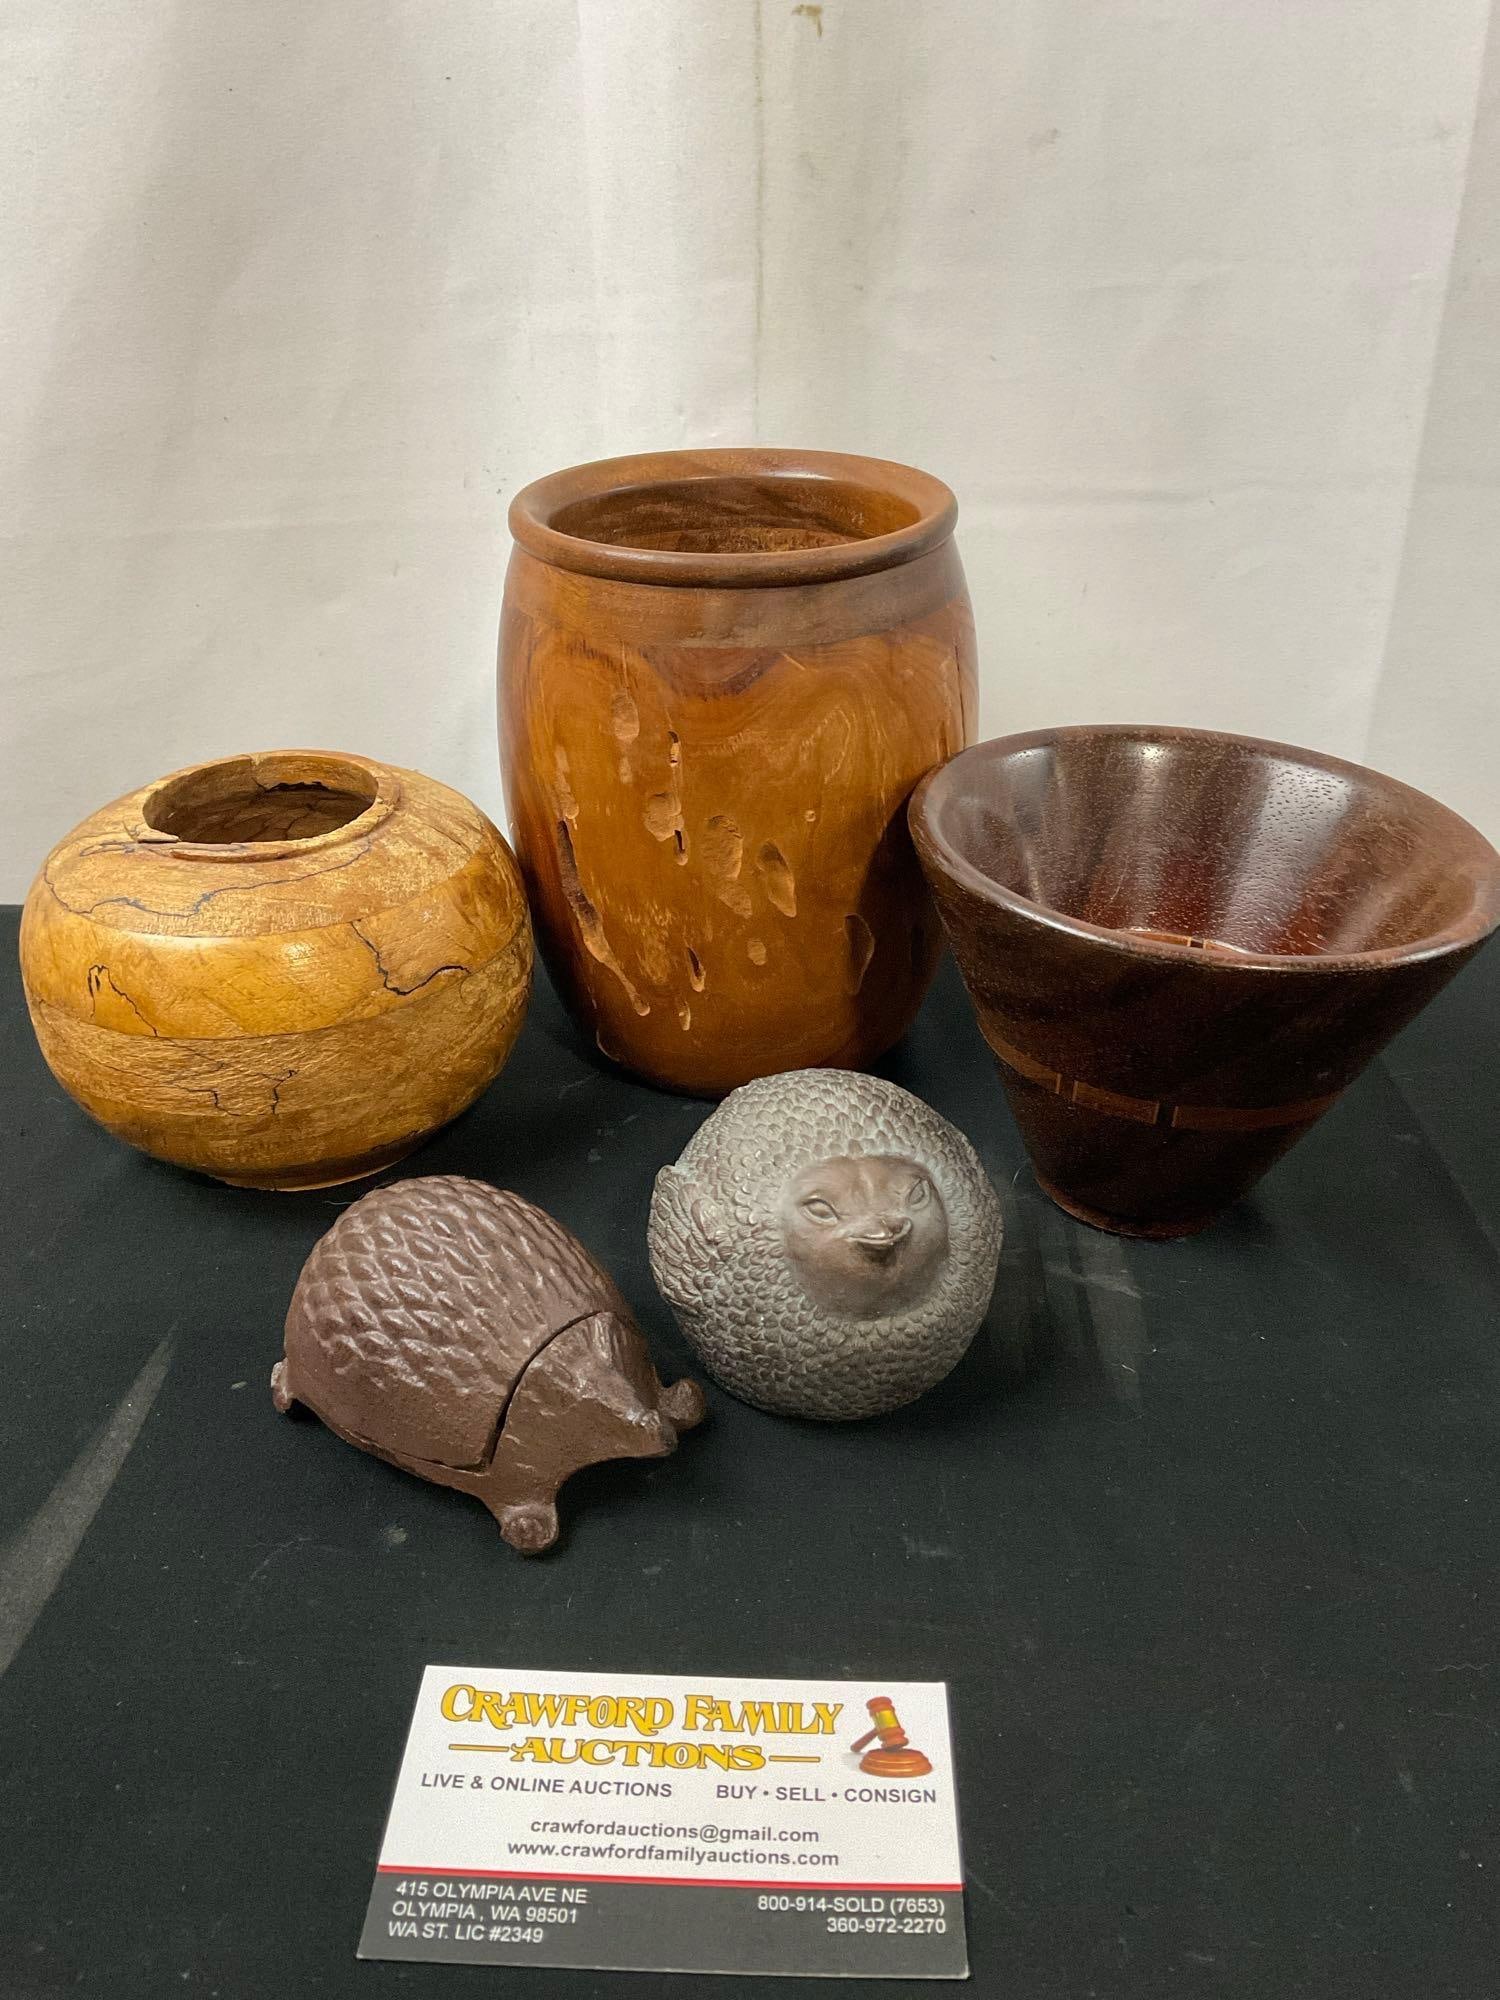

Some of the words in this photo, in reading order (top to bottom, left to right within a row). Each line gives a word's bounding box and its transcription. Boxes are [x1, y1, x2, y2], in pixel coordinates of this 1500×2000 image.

[440, 1684, 674, 1736] CRAWFORD
[682, 1695, 844, 1736] FAMILY
[510, 1737, 766, 1772] AUCTIONS
[421, 1773, 465, 1789] LIVE
[470, 1775, 483, 1790] &
[490, 1776, 565, 1793] ONLINE
[569, 1780, 672, 1798] AUCTIONS
[716, 1784, 758, 1799] BUY
[775, 1787, 826, 1801] SELL
[844, 1788, 936, 1803] CONSIGN
[530, 1820, 820, 1844] crawfordauctions@gmail.com
[507, 1842, 839, 1866] www.crawfordfamilyauctions.com
[396, 1881, 428, 1897] 415
[433, 1882, 515, 1901] OLYMPIA
[518, 1886, 557, 1903] AVE
[561, 1888, 589, 1904] NE
[491, 1905, 521, 1921] WA
[525, 1906, 578, 1923] 98501
[757, 1895, 885, 1913] 800-914-SOLD
[890, 1897, 945, 1916] (7653)
[388, 1920, 418, 1937] WA
[422, 1922, 449, 1940] ST.
[455, 1924, 485, 1941] LIC
[489, 1926, 544, 1943] #2349
[827, 1917, 946, 1934] 360-972-2270
